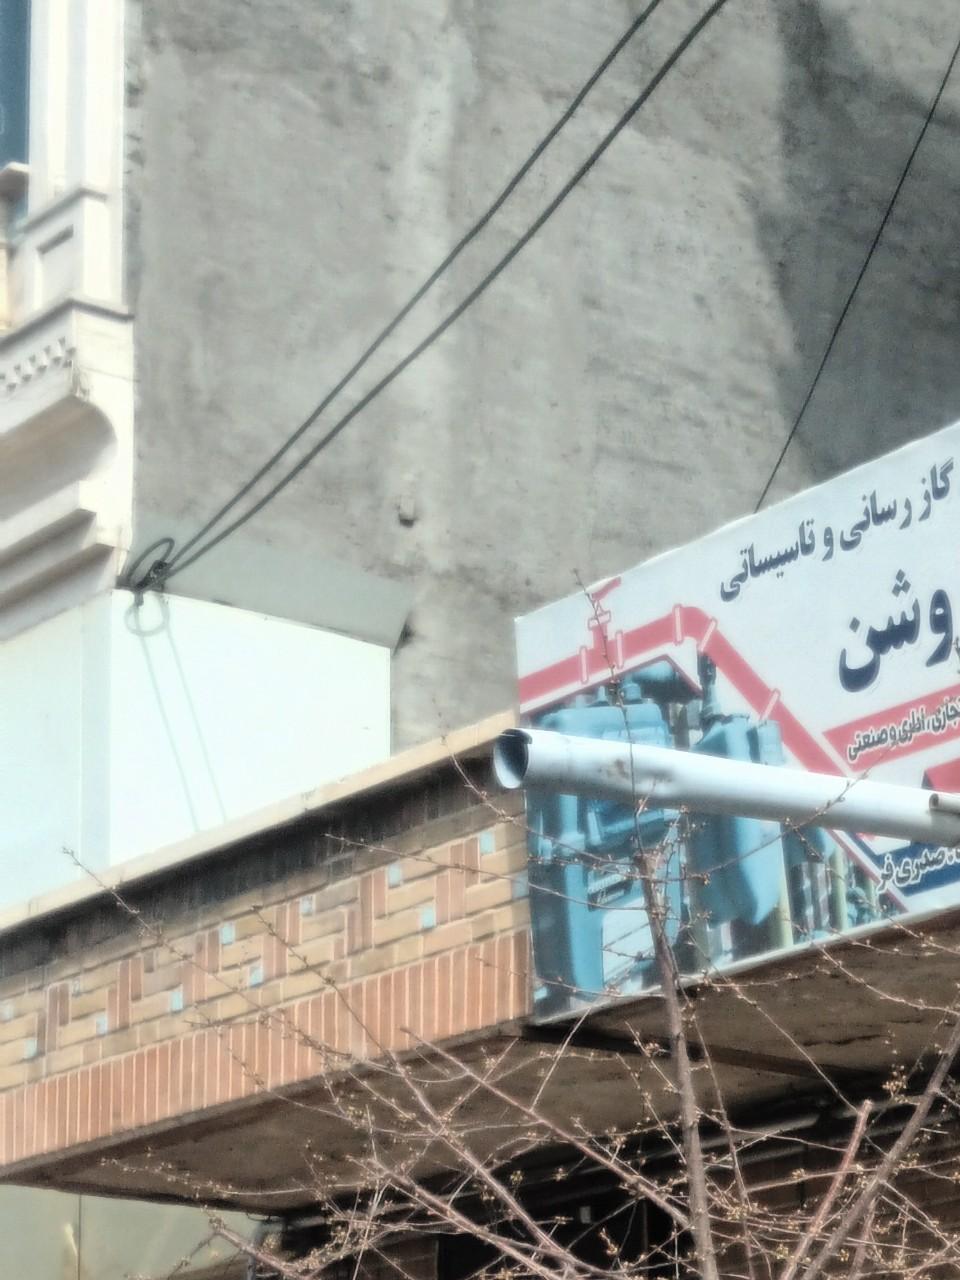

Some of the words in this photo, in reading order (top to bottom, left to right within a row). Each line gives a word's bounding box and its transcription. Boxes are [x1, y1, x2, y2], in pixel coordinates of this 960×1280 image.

[720, 518, 815, 602] تاسیساتی
[822, 526, 834, 561] و
[847, 726, 888, 762] صنعتی
